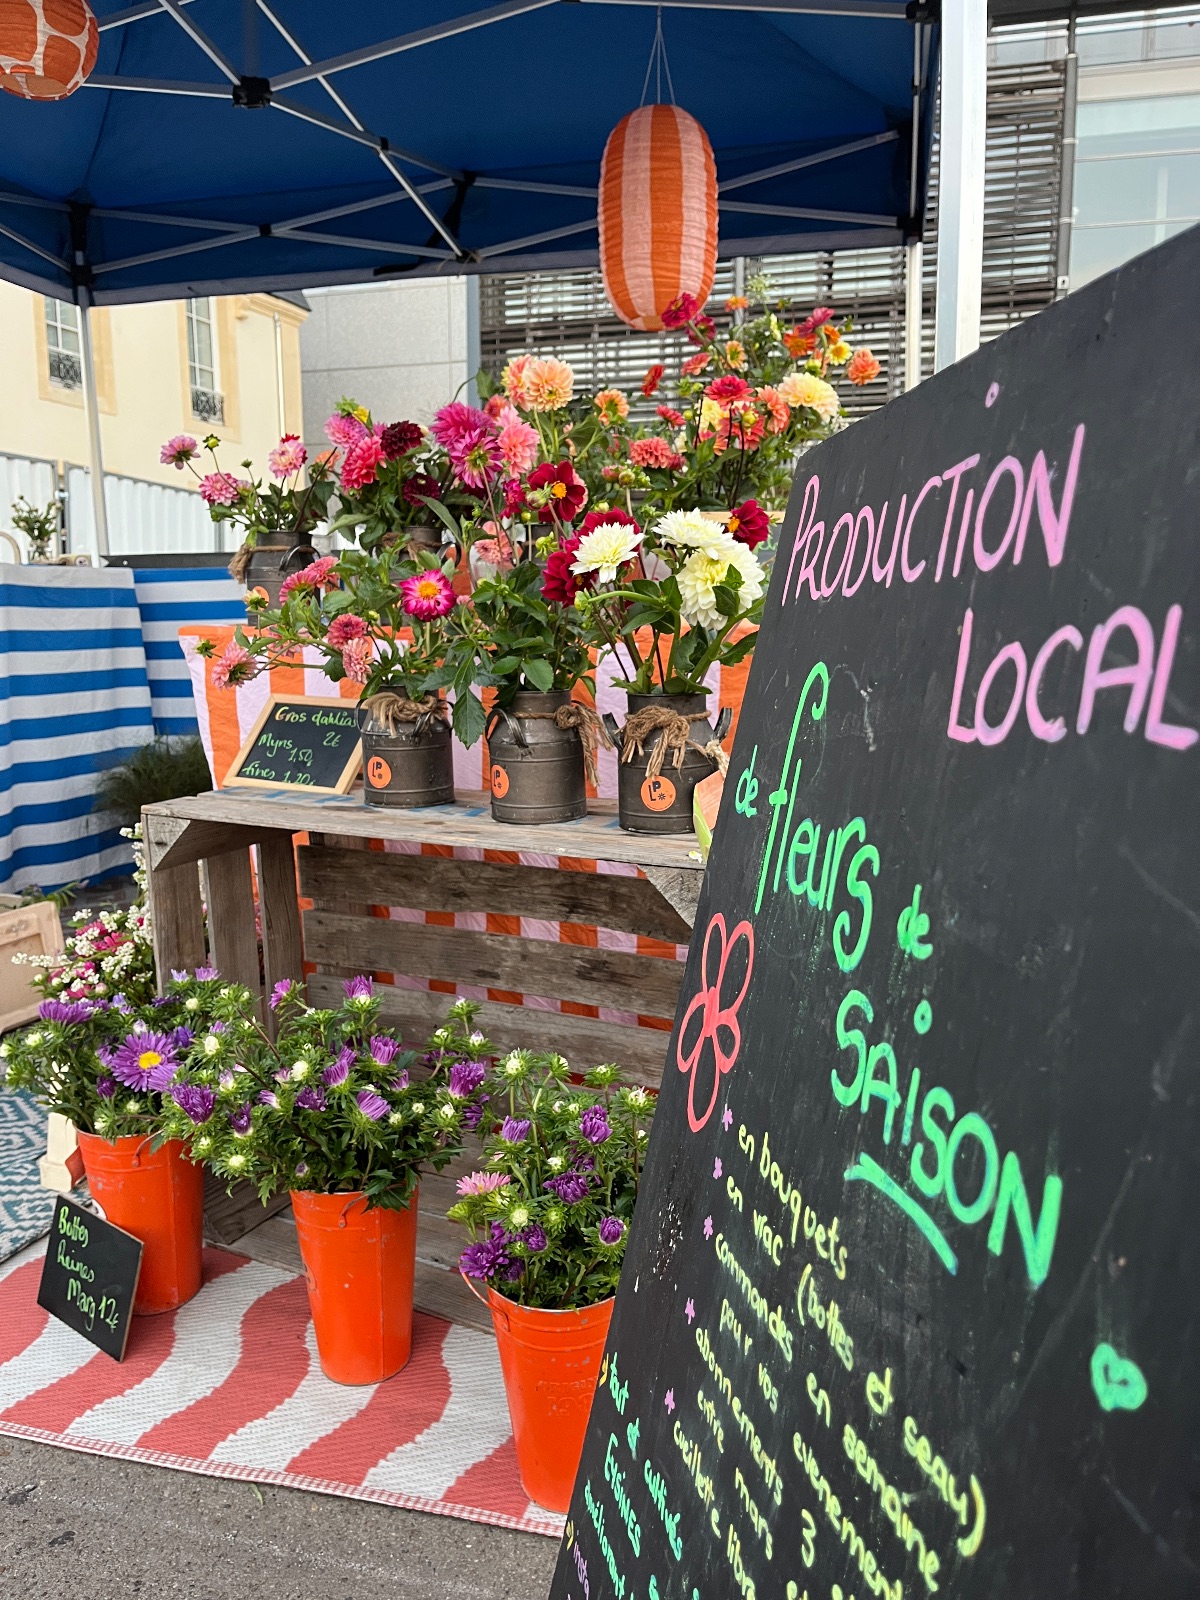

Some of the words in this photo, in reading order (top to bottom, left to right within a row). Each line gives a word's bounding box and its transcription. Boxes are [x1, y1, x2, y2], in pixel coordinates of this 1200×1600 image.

[781, 382, 1085, 607] PRODUCTION
[275, 706, 307, 723] Gros
[947, 604, 1199, 751] LOCAL
[734, 745, 759, 818] de
[754, 661, 881, 972] fleurs
[897, 885, 934, 960] de
[727, 1175, 743, 1212] en
[754, 1209, 783, 1266] vrac
[739, 1124, 755, 1161] en
[760, 1132, 848, 1280] bouquets
[831, 990, 1063, 1288] SAISON
[715, 1233, 793, 1363] commandes
[806, 1372, 831, 1428] en
[719, 1299, 752, 1356] pour
[758, 1362, 778, 1414] vos
[698, 1390, 724, 1453] entre
[735, 1467, 773, 1560] mars
